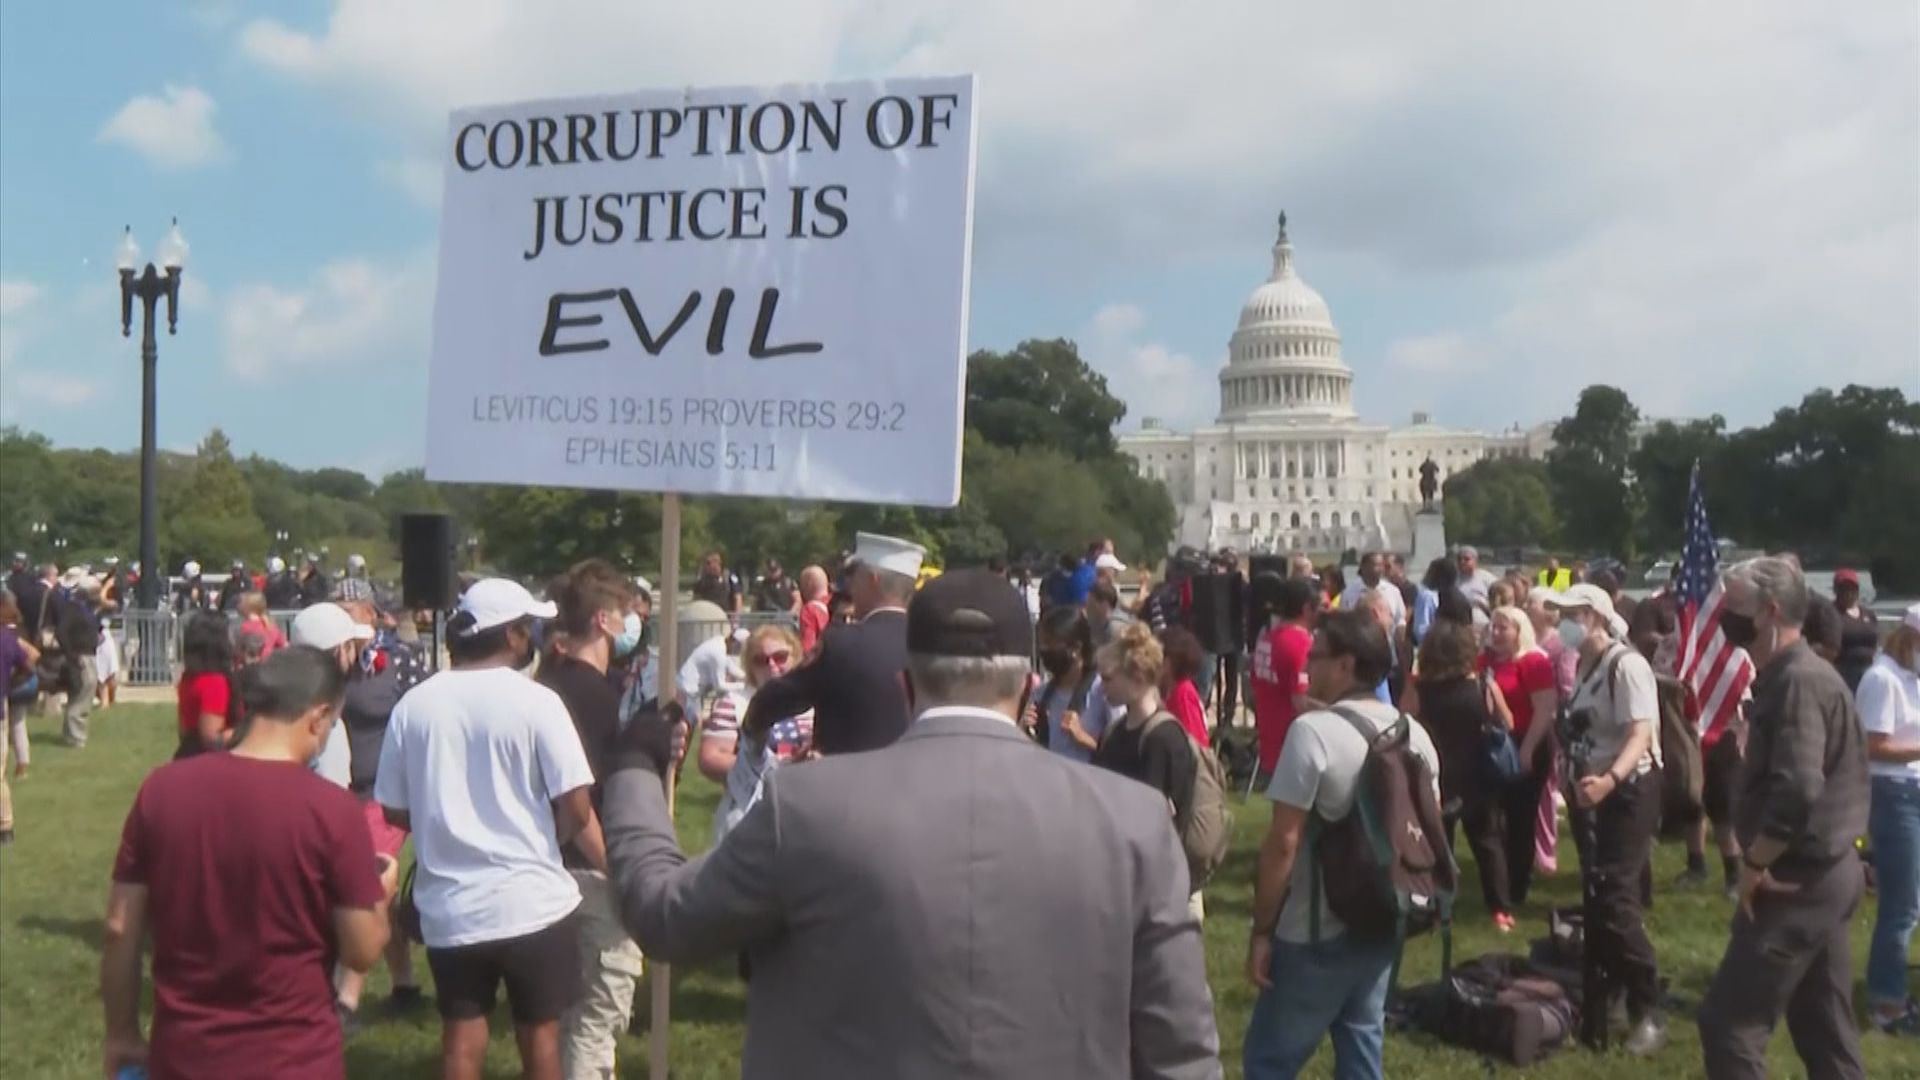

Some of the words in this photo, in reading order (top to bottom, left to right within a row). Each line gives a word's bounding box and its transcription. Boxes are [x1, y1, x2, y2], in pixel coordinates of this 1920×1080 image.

[456, 98, 846, 171] CORRUPTION
[866, 94, 958, 150] OF
[524, 188, 766, 260] JUSTICE
[787, 185, 848, 240] IS
[539, 288, 823, 359] EVIL
[473, 396, 598, 425] LEVITICUS
[608, 399, 673, 426] 19:15
[683, 399, 836, 429] PROVERBS
[846, 401, 906, 431] 29:2
[566, 438, 715, 470] EPHESIANS
[725, 443, 777, 472] 5:11
